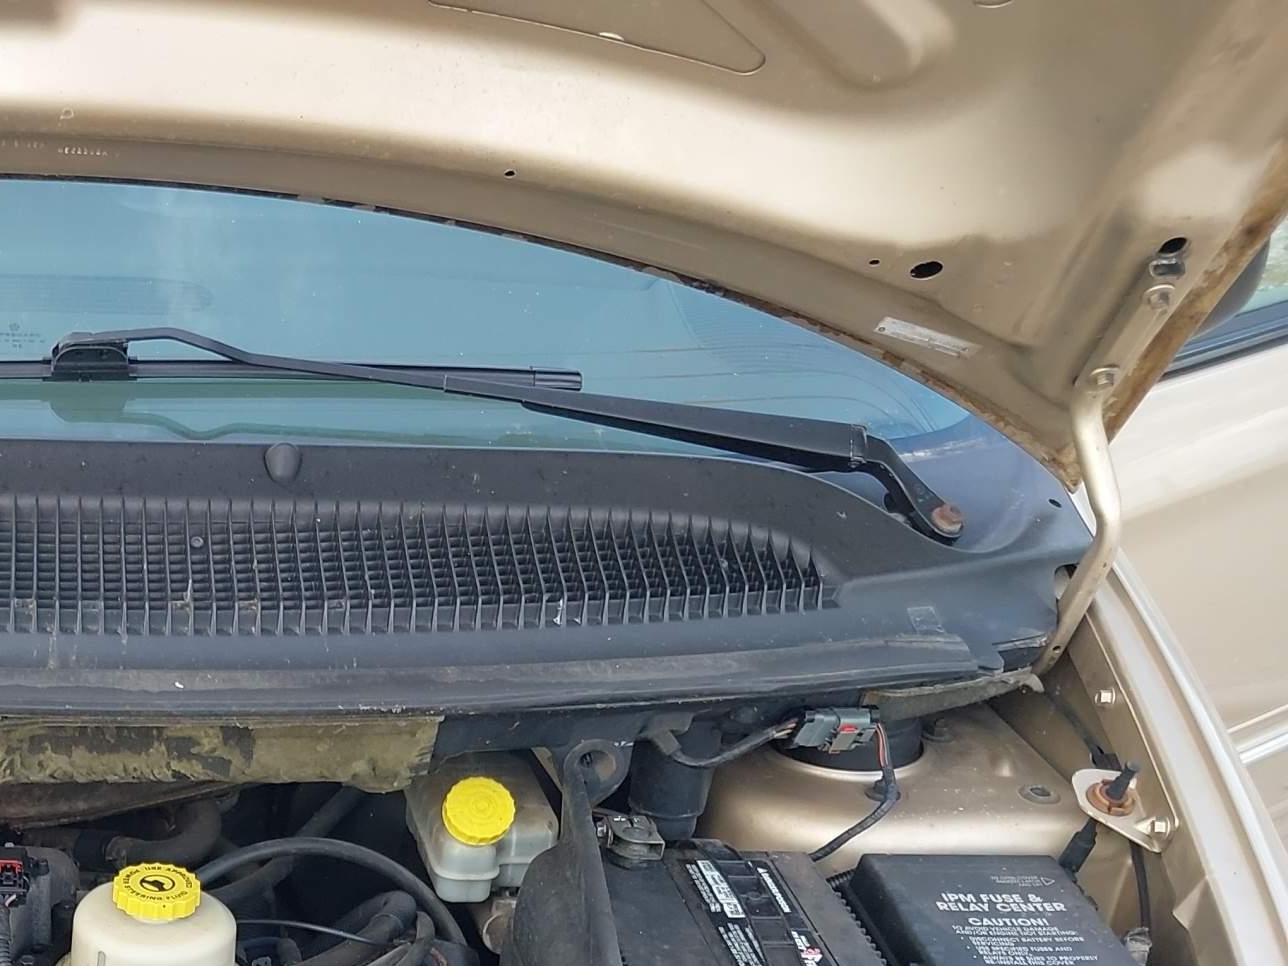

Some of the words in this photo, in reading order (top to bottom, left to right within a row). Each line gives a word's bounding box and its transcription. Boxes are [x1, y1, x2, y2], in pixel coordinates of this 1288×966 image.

[940, 893, 977, 903] IPM
[979, 893, 1024, 903] FUSE
[1028, 894, 1043, 902] &
[935, 901, 989, 911] RELAY
[996, 902, 1067, 912] CENTER
[968, 917, 1049, 926] CAUTION!
